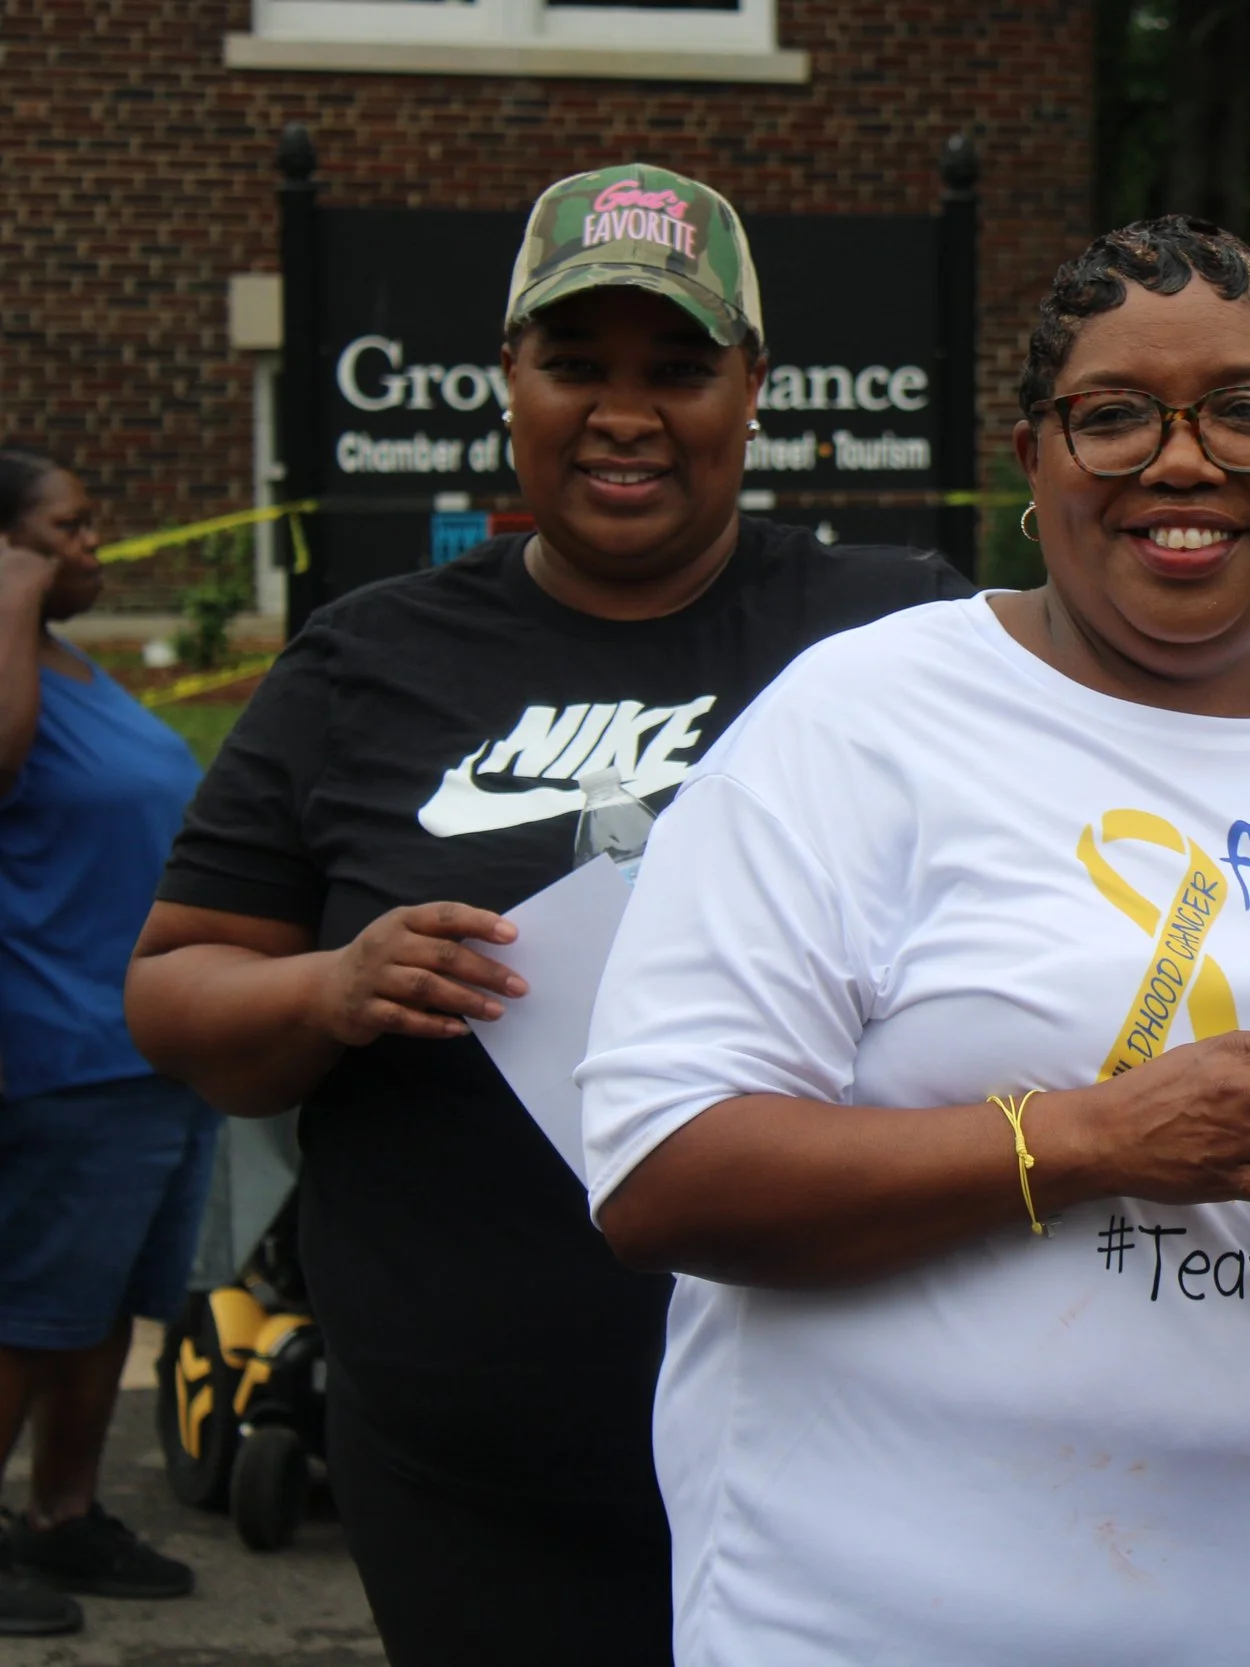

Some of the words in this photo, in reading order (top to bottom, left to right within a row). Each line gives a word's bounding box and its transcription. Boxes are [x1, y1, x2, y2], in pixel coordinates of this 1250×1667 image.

[583, 207, 697, 259] FAVORITE
[337, 431, 464, 473] Chamber
[468, 430, 501, 473] of
[833, 429, 931, 470] Tourism
[477, 695, 717, 782] NIKE
[1165, 870, 1219, 961] CANCER
